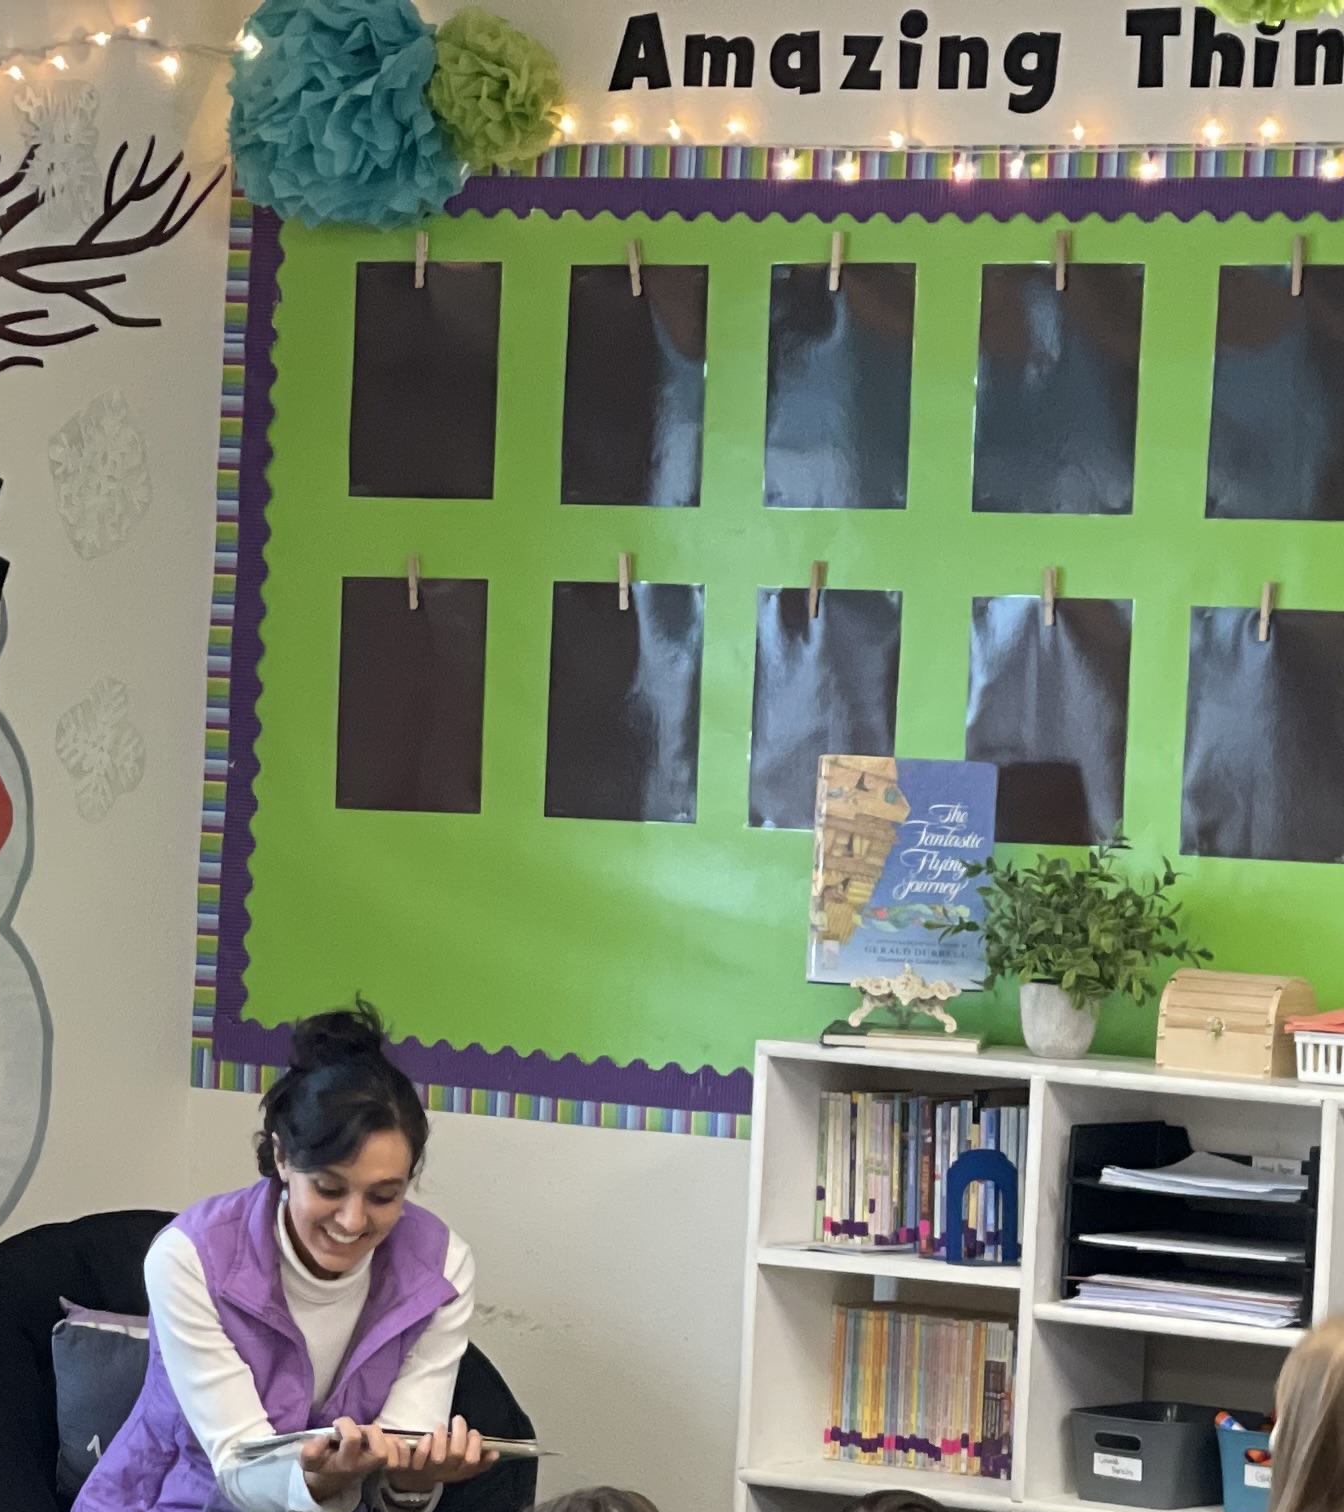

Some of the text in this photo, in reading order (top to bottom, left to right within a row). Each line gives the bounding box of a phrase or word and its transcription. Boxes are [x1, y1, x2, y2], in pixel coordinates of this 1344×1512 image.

[609, 12, 1061, 113] Amazing
[928, 803, 968, 824] The
[900, 820, 985, 848] Fantastic
[900, 847, 967, 881] Flying
[892, 870, 969, 903] Journey
